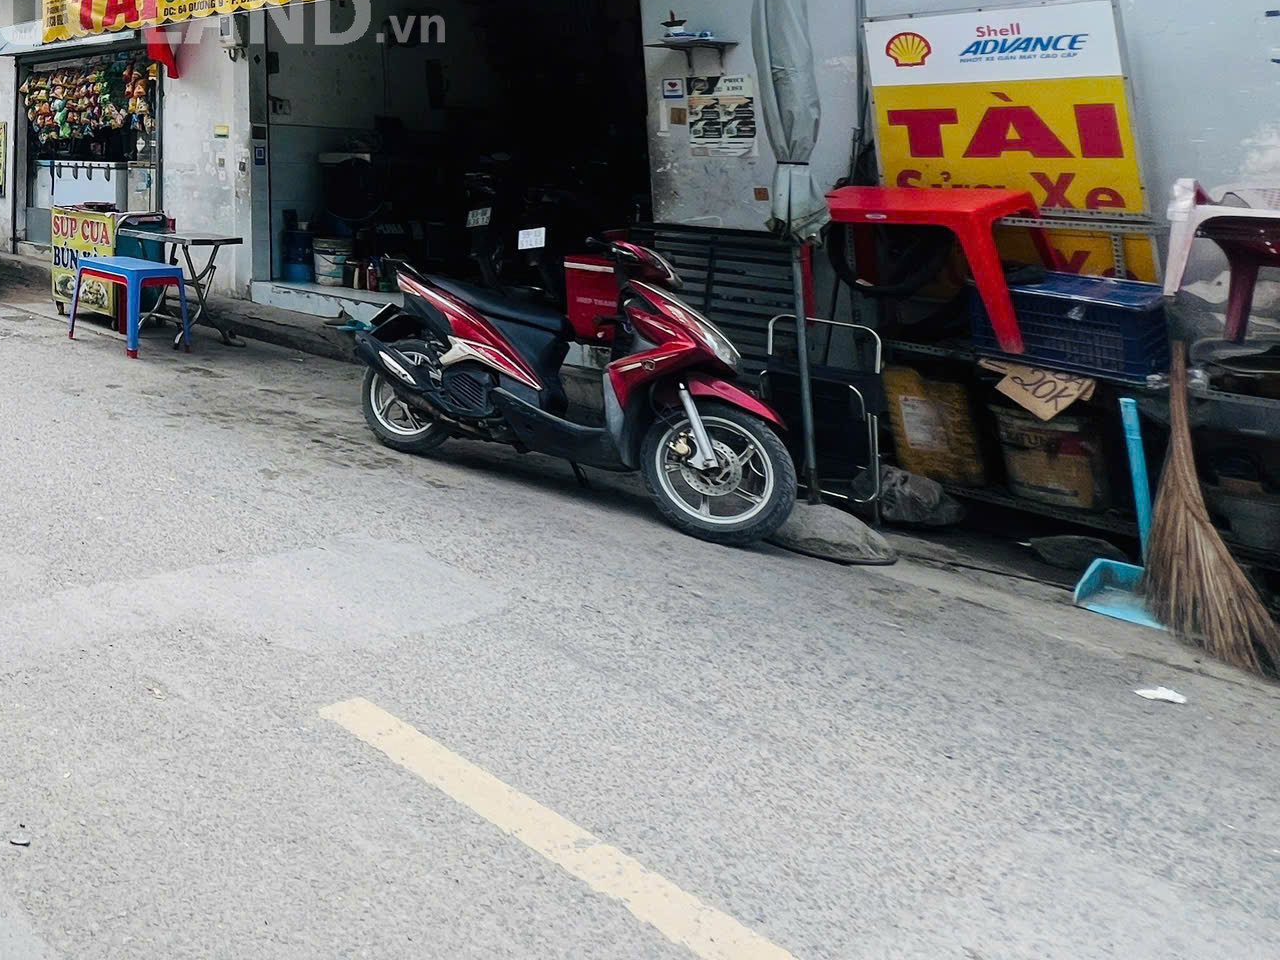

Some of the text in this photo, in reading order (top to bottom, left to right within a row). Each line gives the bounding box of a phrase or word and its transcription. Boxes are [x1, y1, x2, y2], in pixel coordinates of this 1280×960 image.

[976, 23, 1021, 38] Shell
[959, 33, 1089, 57] ADVANCE
[887, 92, 1124, 158] TÀI
[1030, 172, 1126, 210] Xe
[81, 219, 110, 245] CUA
[53, 242, 78, 269] BÚN
[1011, 369, 1074, 411] 20K
